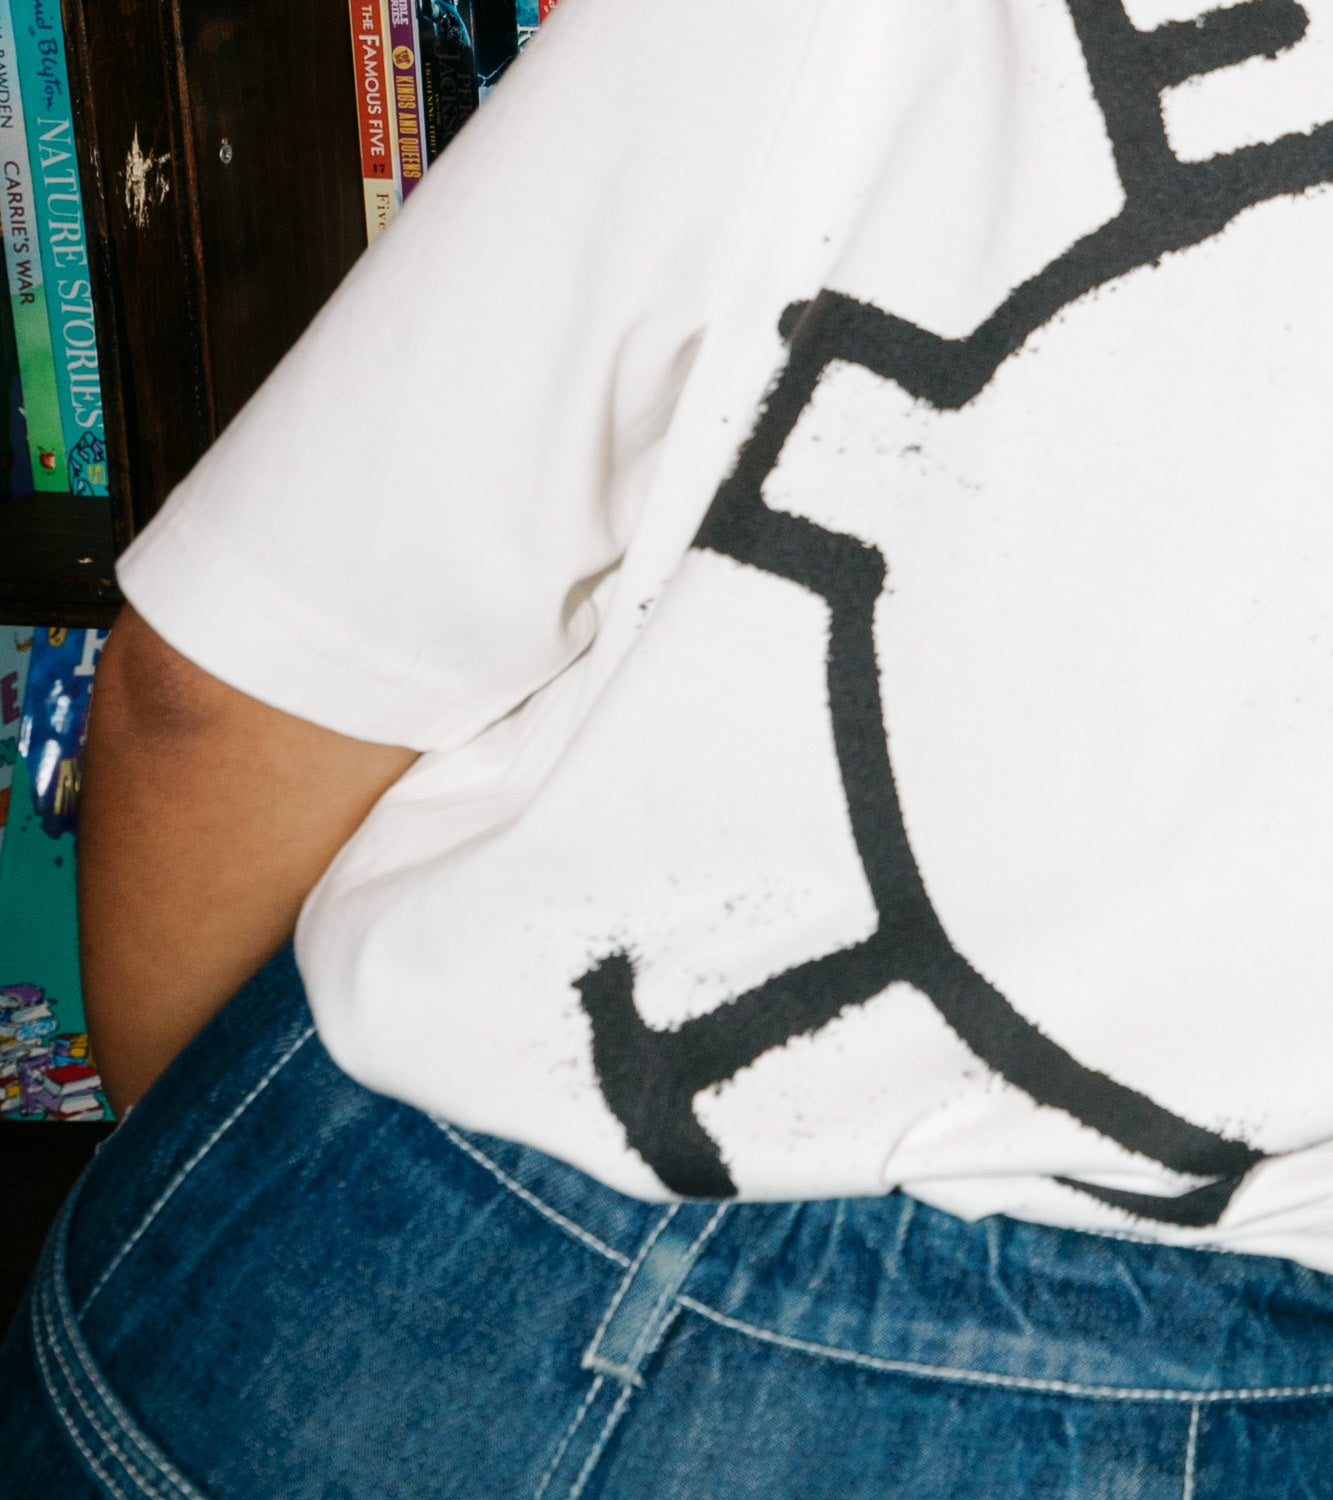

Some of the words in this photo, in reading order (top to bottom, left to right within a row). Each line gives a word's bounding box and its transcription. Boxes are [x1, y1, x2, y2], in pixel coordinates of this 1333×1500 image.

[360, 5, 373, 31] THE
[37, 32, 62, 110] Blyton
[358, 33, 382, 115] FAMOUS
[395, 76, 416, 109] KINGS
[368, 119, 385, 157] FIVE
[398, 112, 418, 136] AND
[400, 138, 422, 178] QUEENS
[3, 161, 30, 254] CARRIE'S
[37, 116, 87, 268] NATURE
[15, 259, 35, 305] WAR
[58, 278, 104, 428] STORIES
